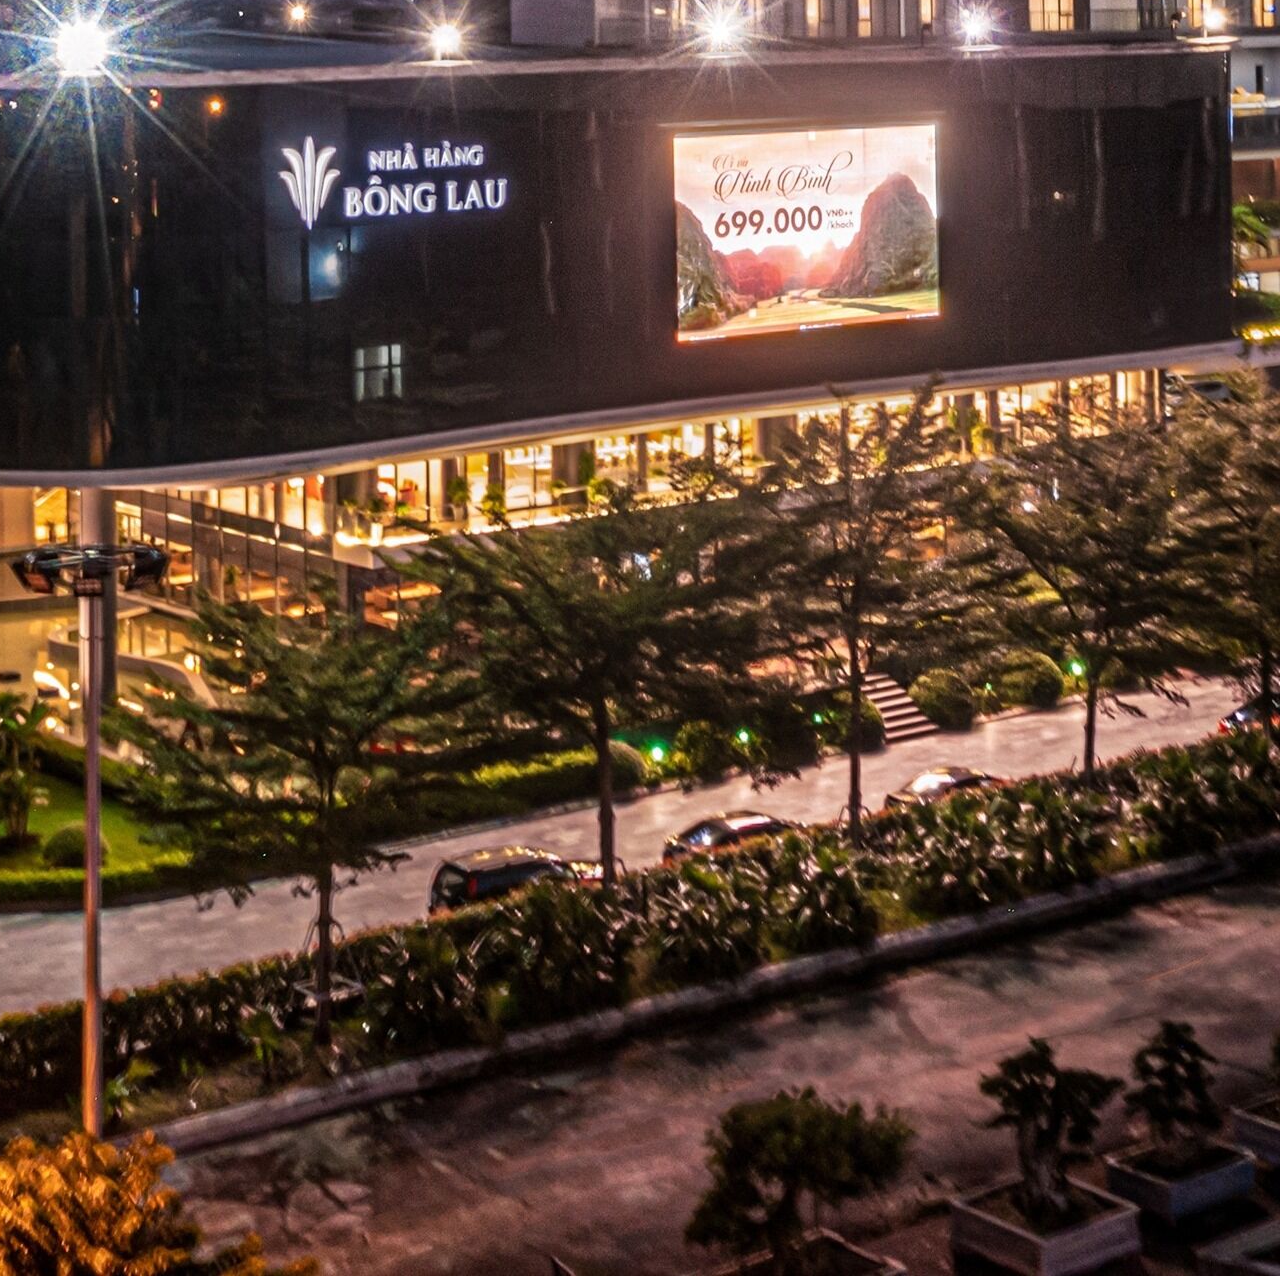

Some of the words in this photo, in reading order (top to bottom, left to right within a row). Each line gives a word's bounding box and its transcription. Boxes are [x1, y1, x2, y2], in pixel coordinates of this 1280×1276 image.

[369, 142, 418, 172] NHÀ
[424, 140, 484, 167] HÀNG
[343, 174, 437, 218] BÔNG
[445, 178, 508, 212] LAU
[713, 166, 772, 204] Ninh
[714, 205, 822, 238] 699.000
